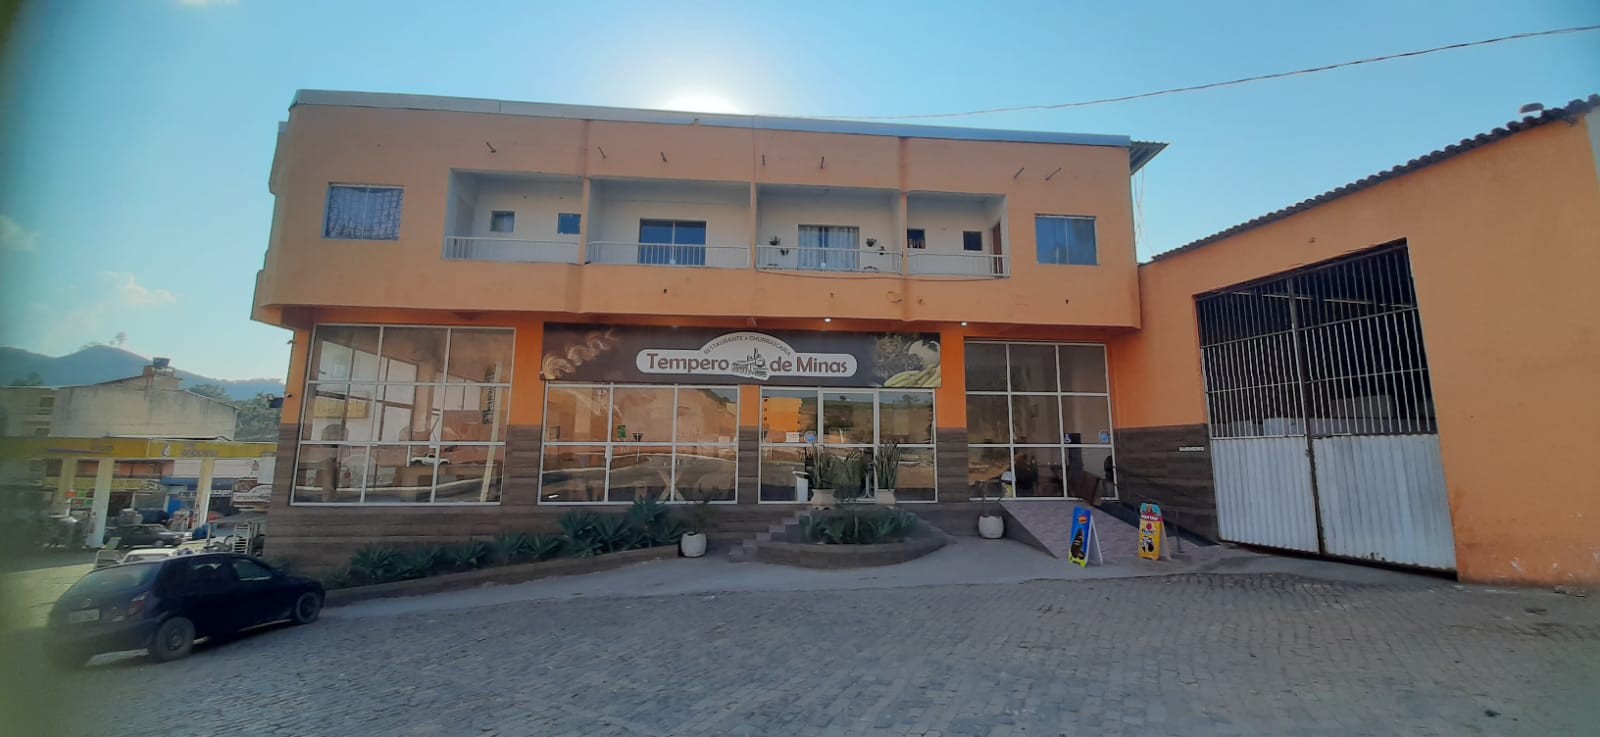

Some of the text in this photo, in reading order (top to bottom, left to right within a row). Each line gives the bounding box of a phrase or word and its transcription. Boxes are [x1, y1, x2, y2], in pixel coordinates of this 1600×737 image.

[704, 336, 791, 356] RESTAURANTE CHURRASCARIA
[646, 352, 848, 373] Tempero de Minas
